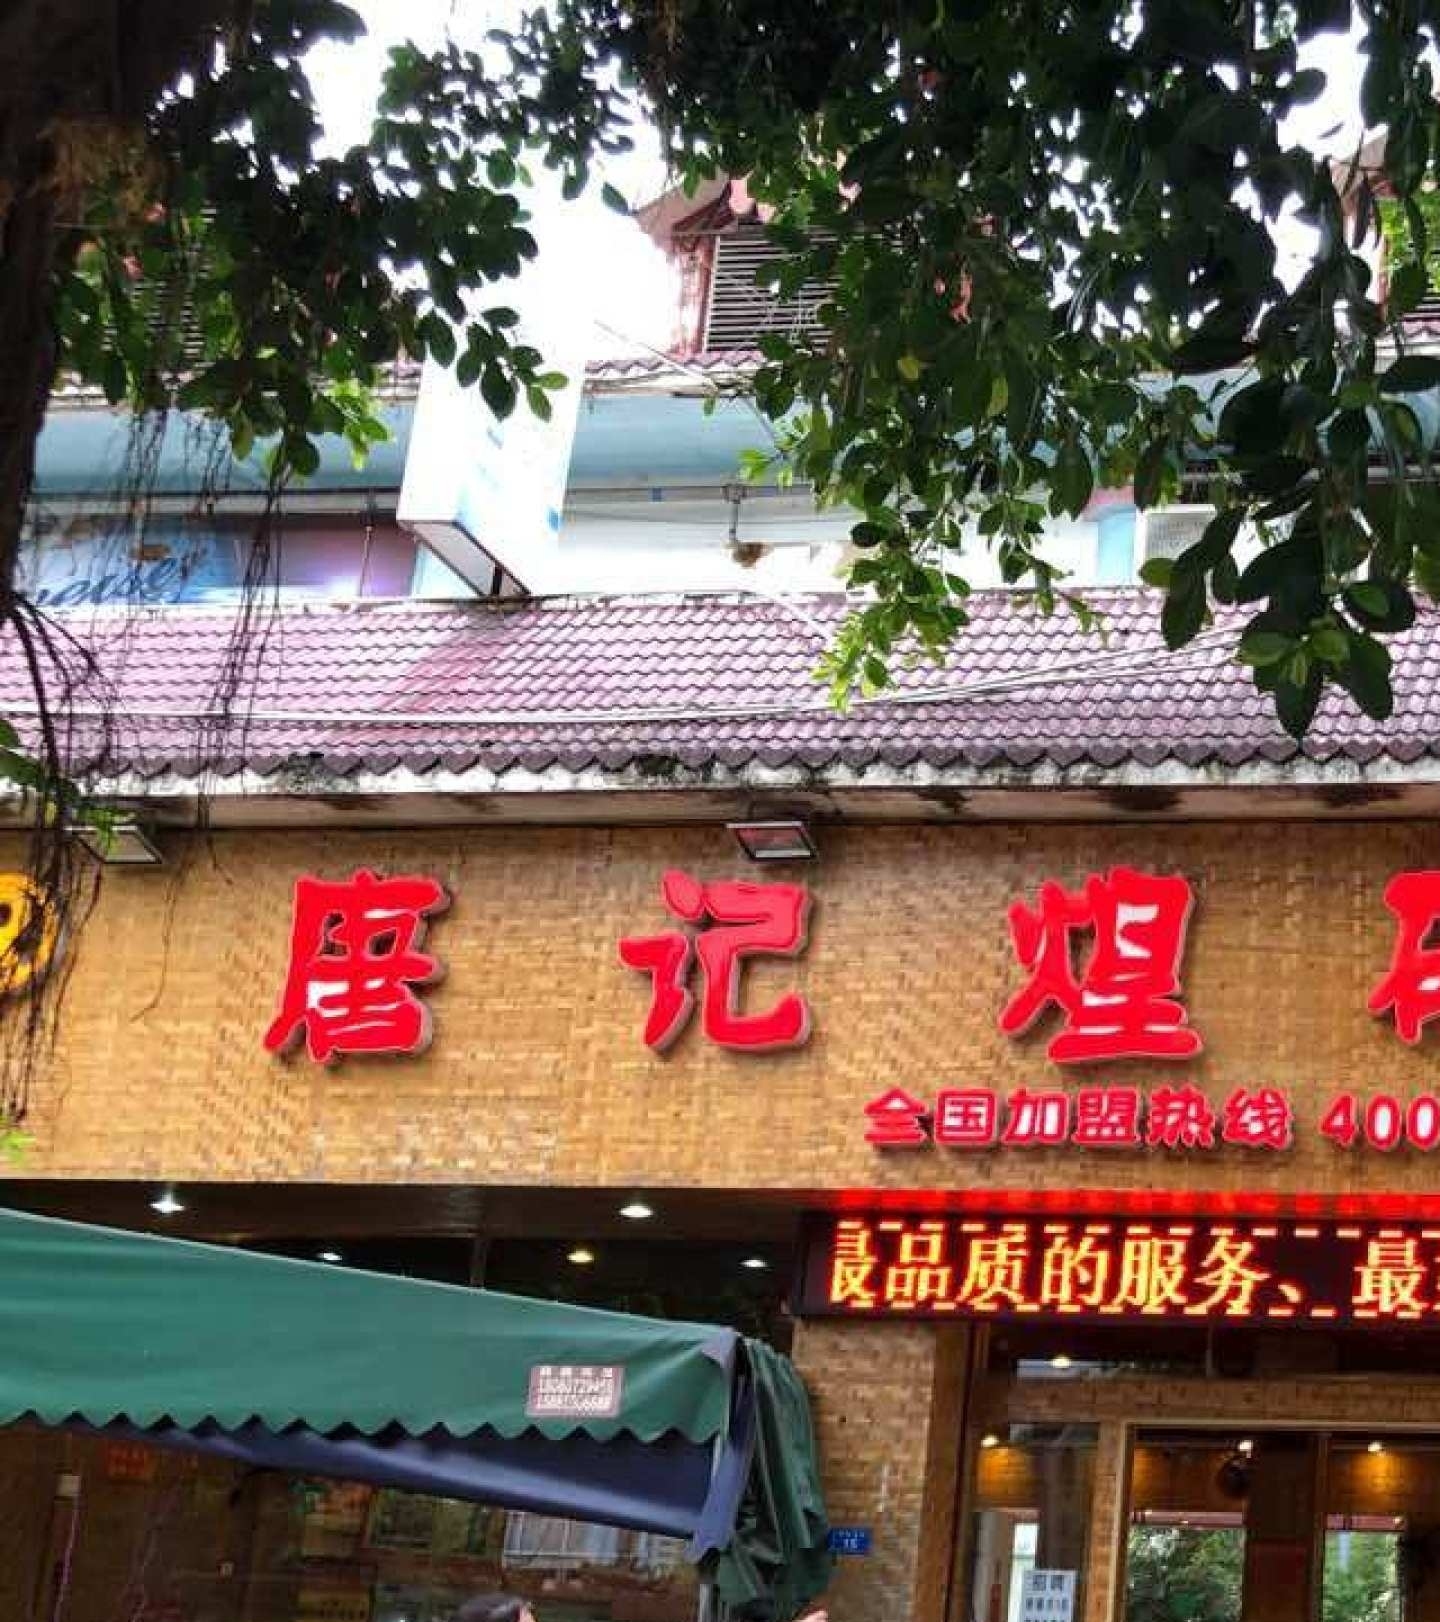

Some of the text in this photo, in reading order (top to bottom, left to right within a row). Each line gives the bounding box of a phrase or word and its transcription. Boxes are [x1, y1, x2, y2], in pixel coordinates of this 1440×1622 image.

[864, 1085, 1294, 1149] 全国加盟热线
